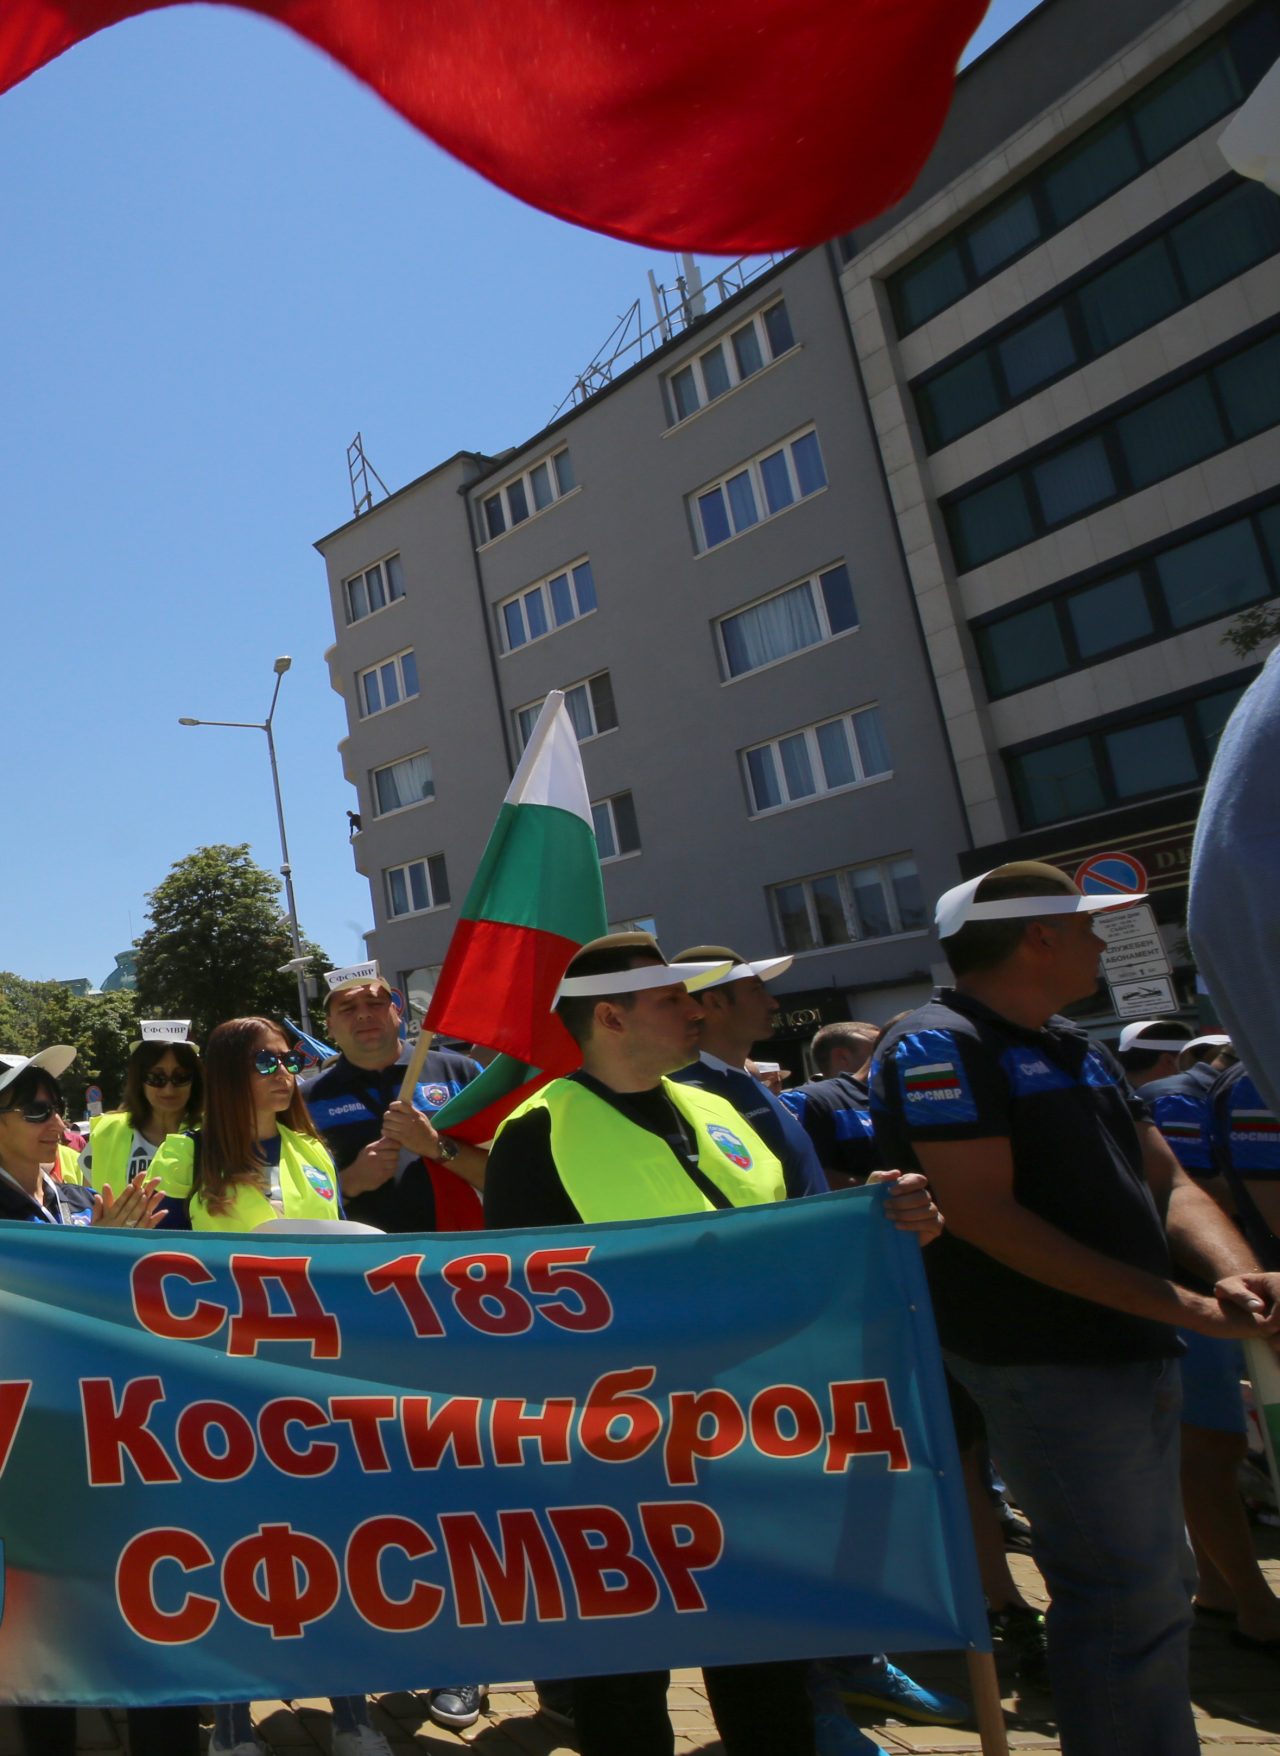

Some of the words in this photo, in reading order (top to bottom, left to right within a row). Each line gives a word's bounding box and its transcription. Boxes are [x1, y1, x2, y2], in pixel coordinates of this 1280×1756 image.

[1106, 948, 1160, 964] АБОНАМЕНТ
[328, 968, 374, 983] СФСМВР
[906, 1088, 963, 1103] СФСМВР
[328, 1102, 366, 1117] СФСМВ
[1230, 1131, 1280, 1143] СФСМВ
[129, 1250, 342, 1360] СД
[365, 1245, 614, 1339] 185
[78, 1366, 912, 1488] Костинброд
[115, 1500, 725, 1646] СФСМВР
